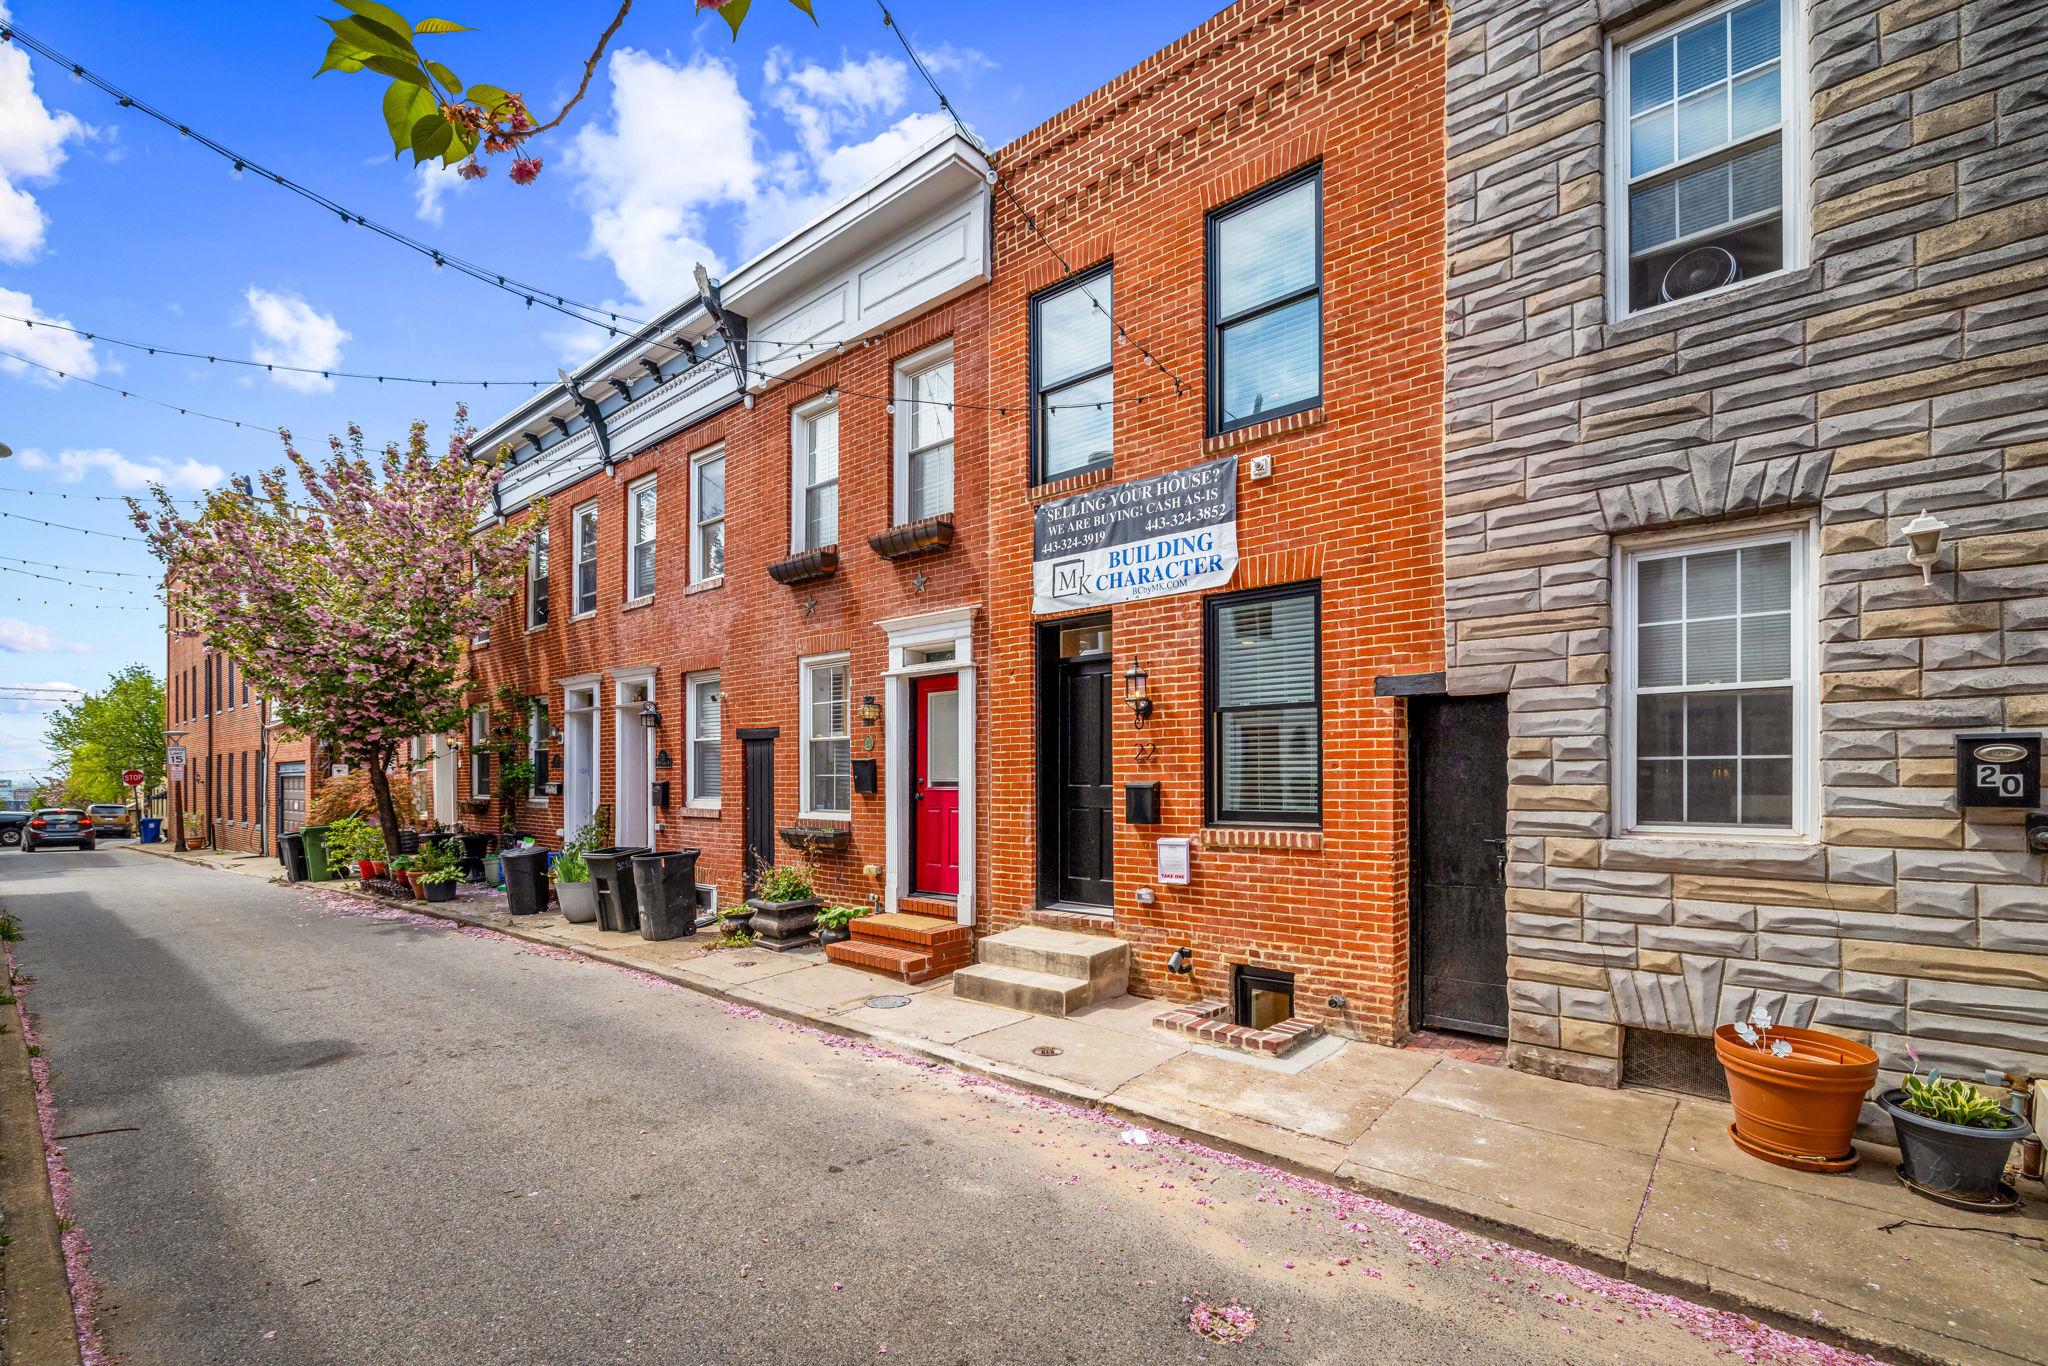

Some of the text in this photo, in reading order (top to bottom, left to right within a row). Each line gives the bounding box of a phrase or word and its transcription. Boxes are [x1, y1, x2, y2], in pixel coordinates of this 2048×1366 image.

[1047, 468, 1220, 523] SELLING YOUR HOUSE?
[1048, 488, 1218, 537] WE ARE BUYING! CASH AS-IS
[1145, 503, 1226, 532] 443-324-3852
[1041, 531, 1106, 554] 443-324-3919
[1109, 531, 1213, 569] BUILDING
[1095, 554, 1224, 591] CHARACTER
[1132, 579, 1188, 596] BCbyMK.COM
[1134, 743, 1156, 761] 22
[1981, 766, 2021, 795] 20
